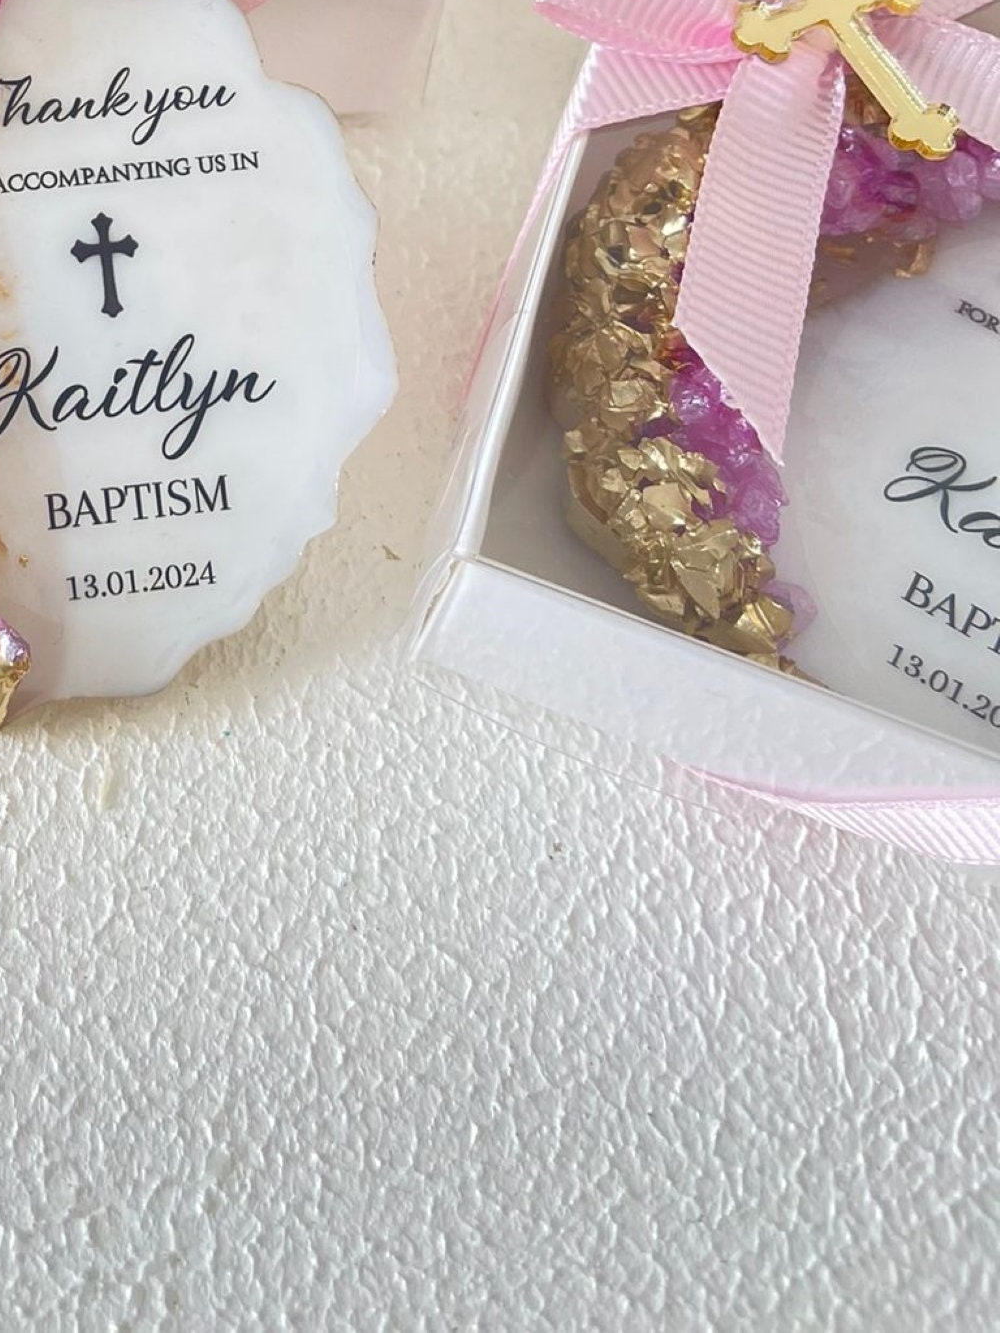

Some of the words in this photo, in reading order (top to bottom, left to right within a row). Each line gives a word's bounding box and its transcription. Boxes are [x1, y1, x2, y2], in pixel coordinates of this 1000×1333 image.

[131, 80, 236, 146] you
[195, 154, 227, 174] US
[230, 150, 260, 172] IN
[954, 299, 999, 335] FOR
[44, 473, 232, 530] BAPTISM
[65, 560, 217, 602] 13.01.2024
